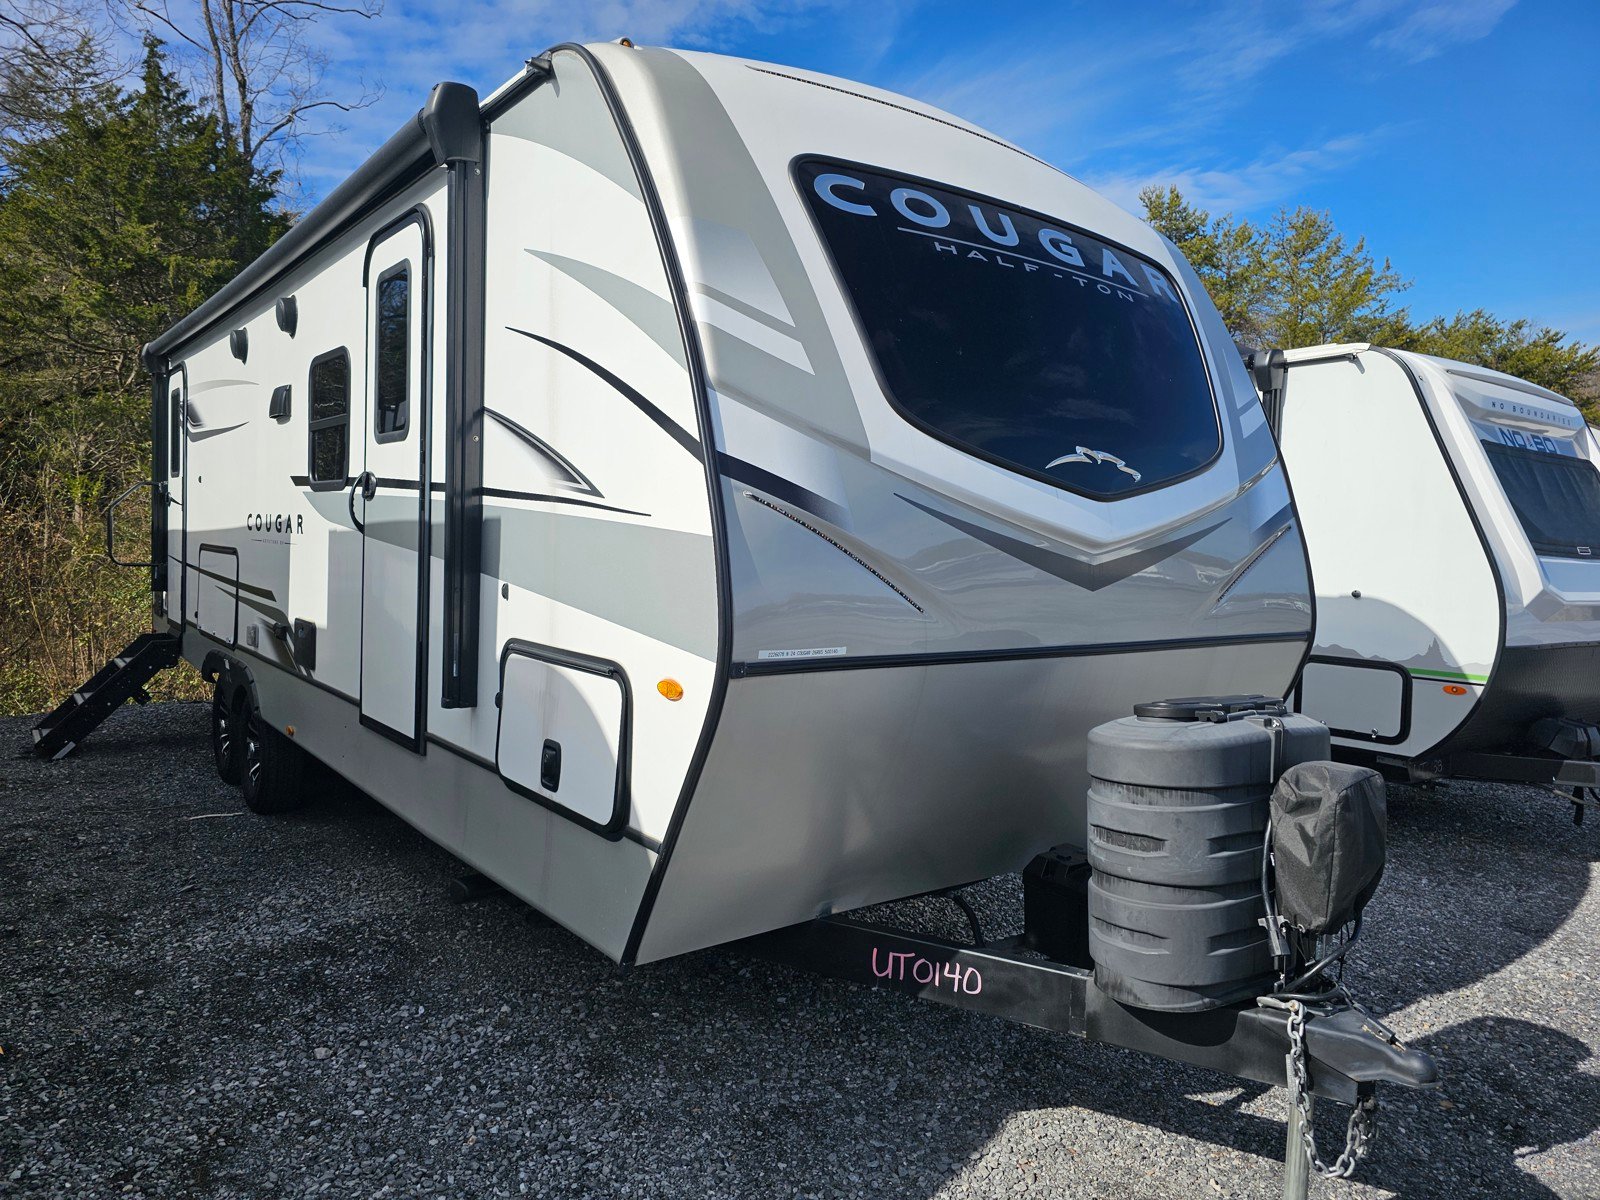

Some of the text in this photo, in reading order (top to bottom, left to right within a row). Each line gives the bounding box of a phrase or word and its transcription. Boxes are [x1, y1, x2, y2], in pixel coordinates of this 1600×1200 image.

[813, 173, 1180, 304] COUGAR
[933, 241, 1135, 304] HALF-TON
[1492, 402, 1571, 426] NO BOUNDARIES
[246, 513, 304, 535] COUGAR
[872, 947, 982, 995] UT0140
